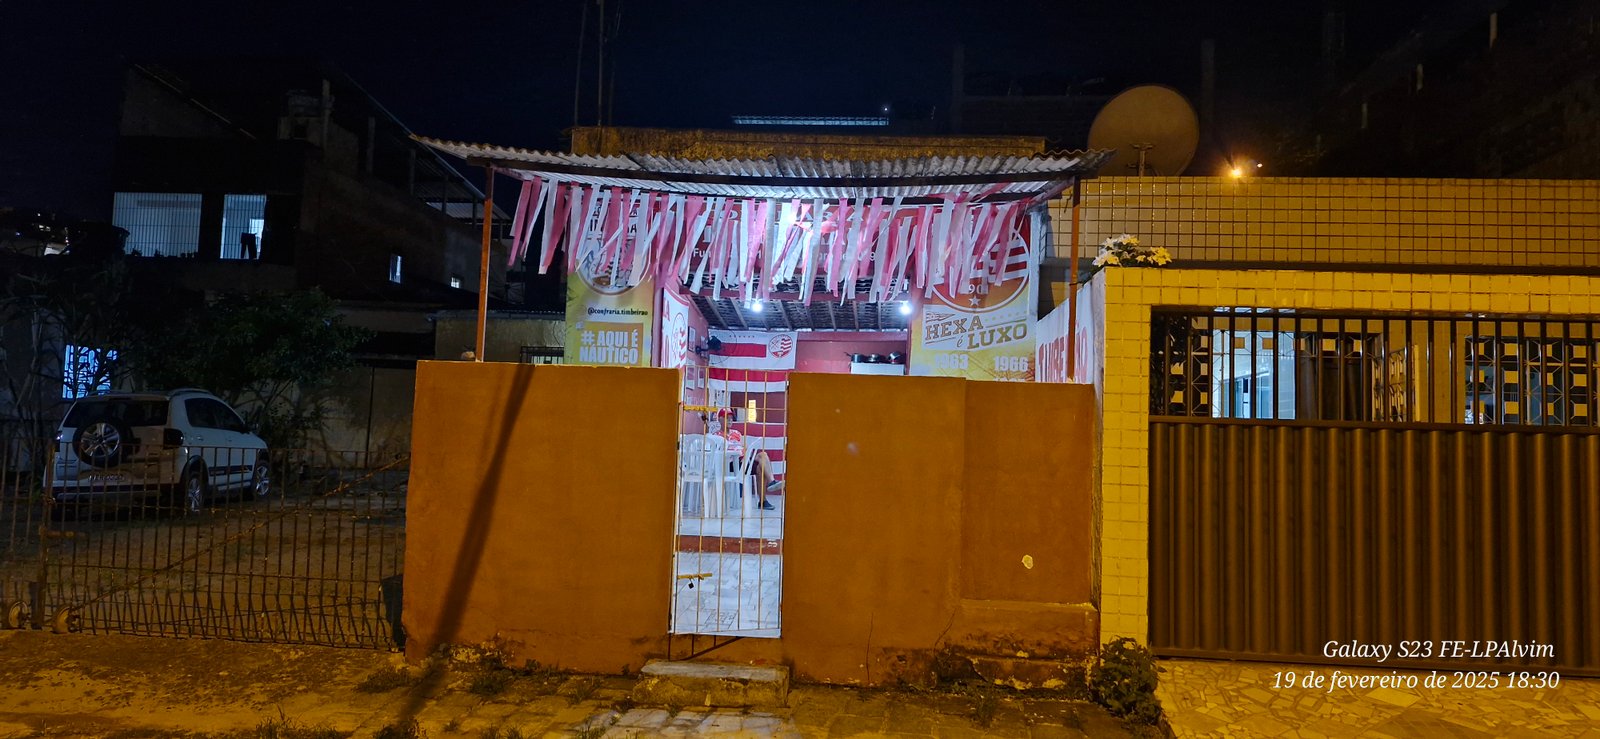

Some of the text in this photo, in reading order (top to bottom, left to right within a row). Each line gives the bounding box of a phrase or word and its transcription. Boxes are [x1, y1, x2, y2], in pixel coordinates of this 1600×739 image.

[925, 315, 983, 341] HEXA
[967, 323, 1027, 349] LUXO
[597, 330, 629, 347] AQUI
[631, 329, 639, 347] É
[580, 344, 638, 364] NÁUTICO
[935, 353, 969, 370] 1963
[994, 356, 1029, 372] 1966
